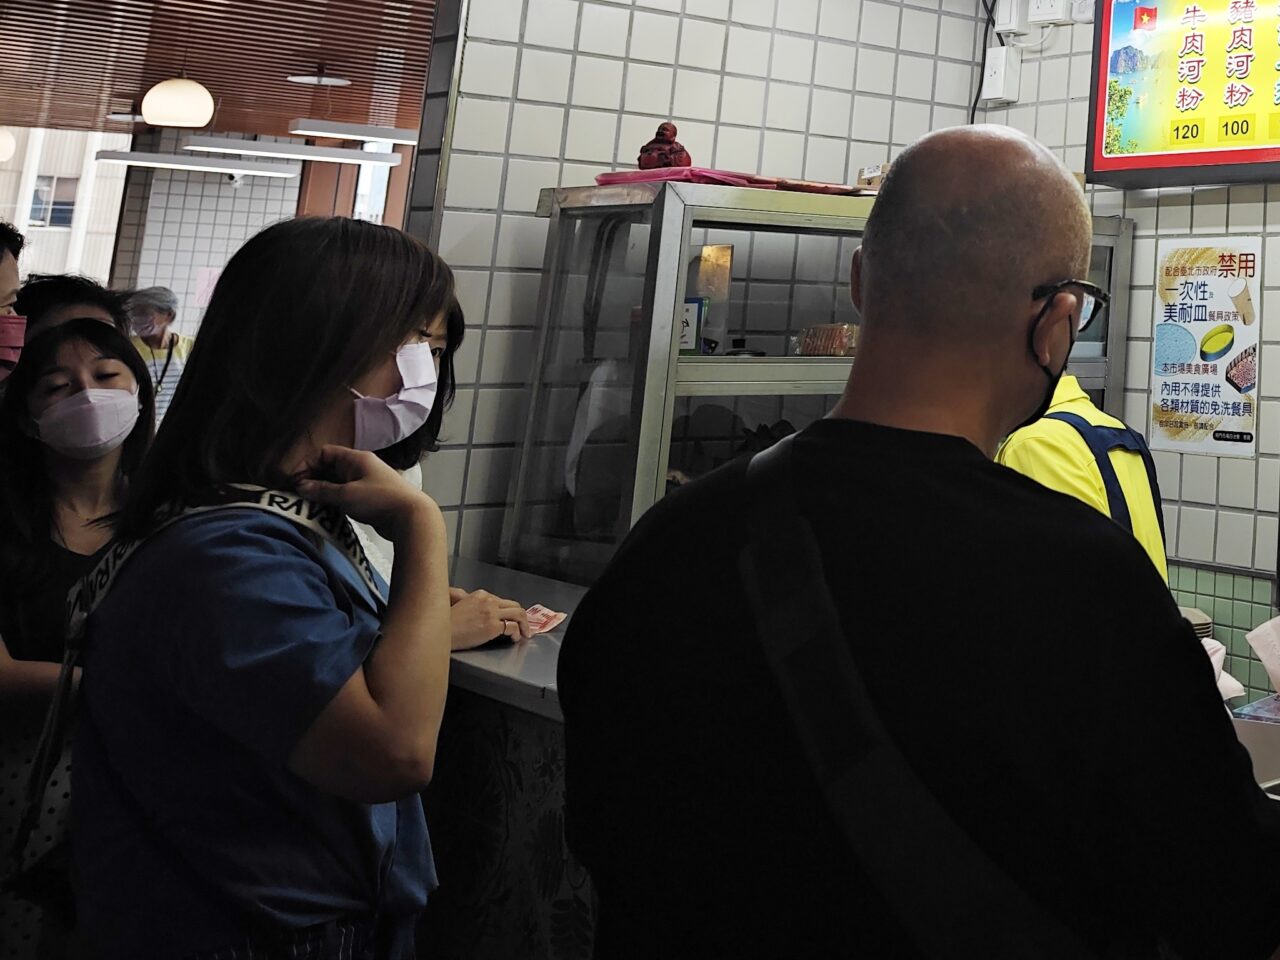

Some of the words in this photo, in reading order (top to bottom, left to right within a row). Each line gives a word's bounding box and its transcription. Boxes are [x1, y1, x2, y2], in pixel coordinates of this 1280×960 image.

[1177, 6, 1206, 111] 牛肉河粉
[1173, 124, 1199, 140] 120
[1222, 120, 1249, 136] 100
[1217, 253, 1256, 279] 禁用
[1165, 280, 1208, 301] 一次性
[1163, 303, 1208, 323] 美耐皿
[1161, 363, 1218, 375] 本市場美食廣場
[1160, 398, 1252, 417] 各類材質的免洗餐具
